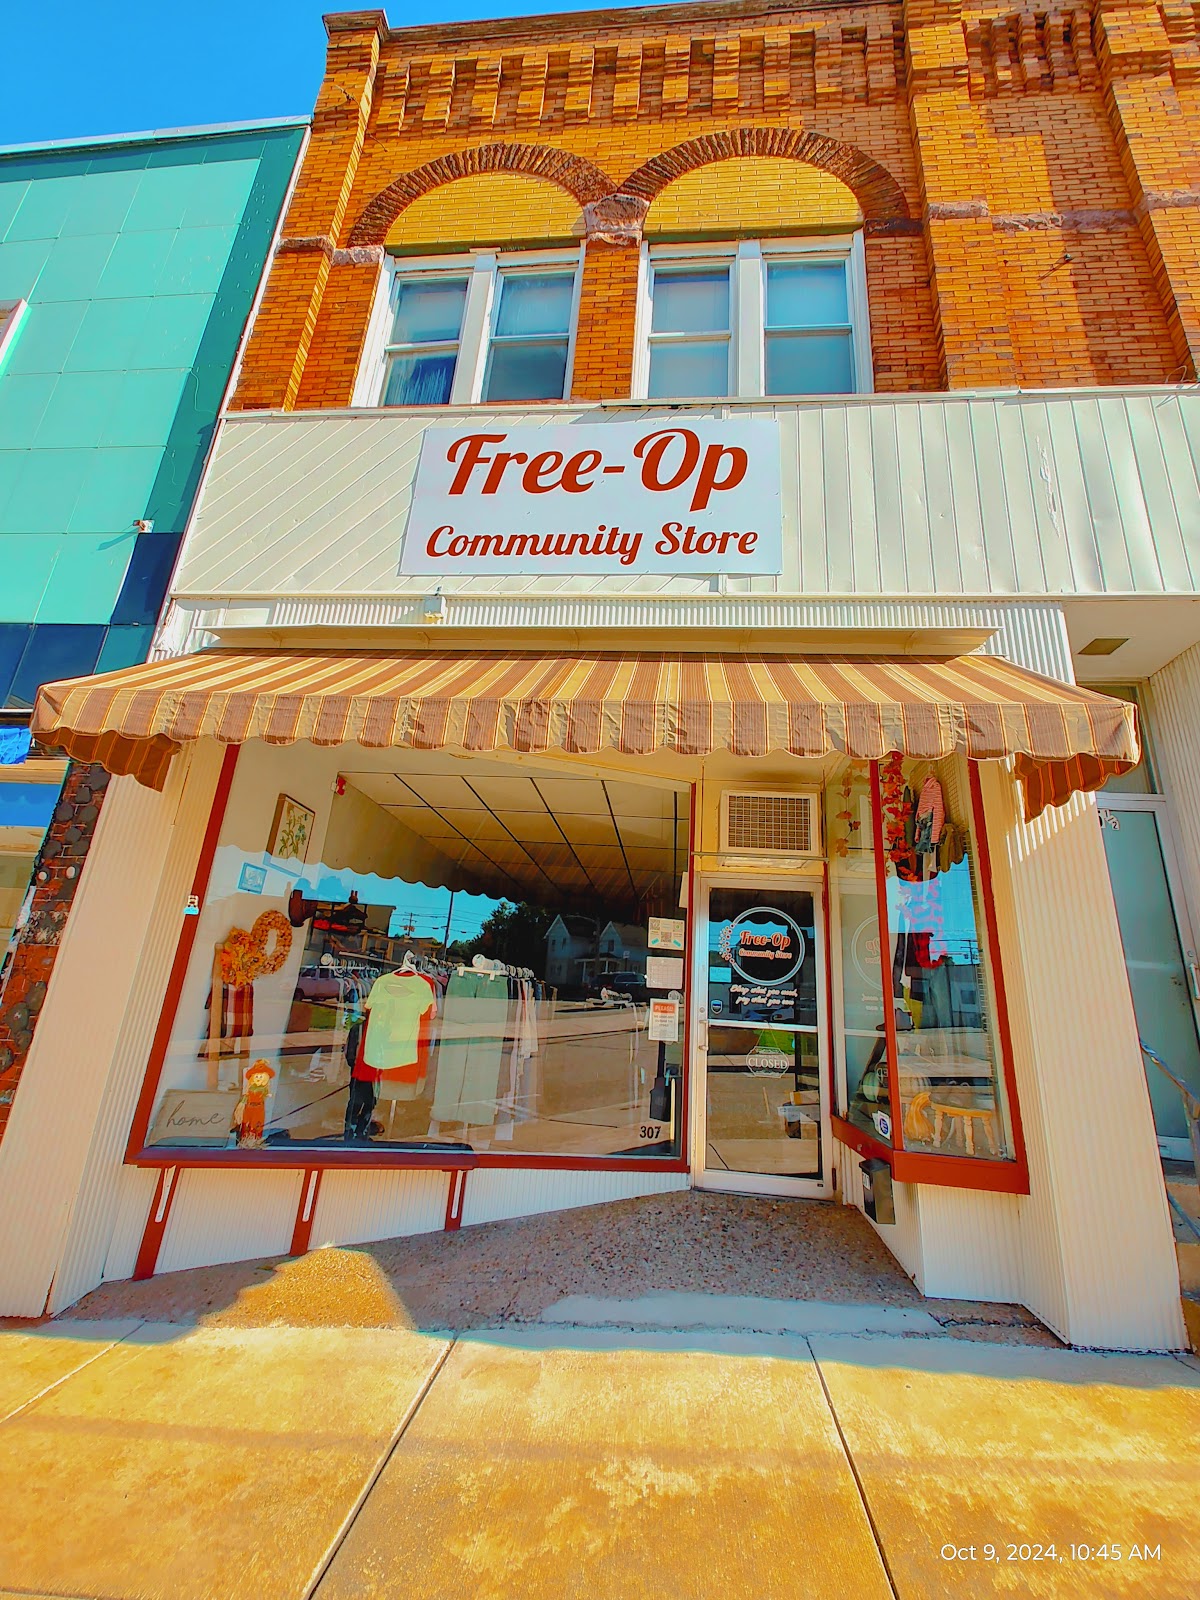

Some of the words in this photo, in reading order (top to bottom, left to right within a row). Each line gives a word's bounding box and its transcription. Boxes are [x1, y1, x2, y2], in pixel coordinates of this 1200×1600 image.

[446, 428, 748, 512] Free-Op
[426, 524, 643, 565] Community
[655, 522, 759, 555] Store
[740, 930, 791, 950] Free-Op
[739, 948, 775, 960] Community
[748, 1057, 788, 1069] CLOSED
[166, 1100, 225, 1128] home
[640, 1125, 662, 1139] 307
